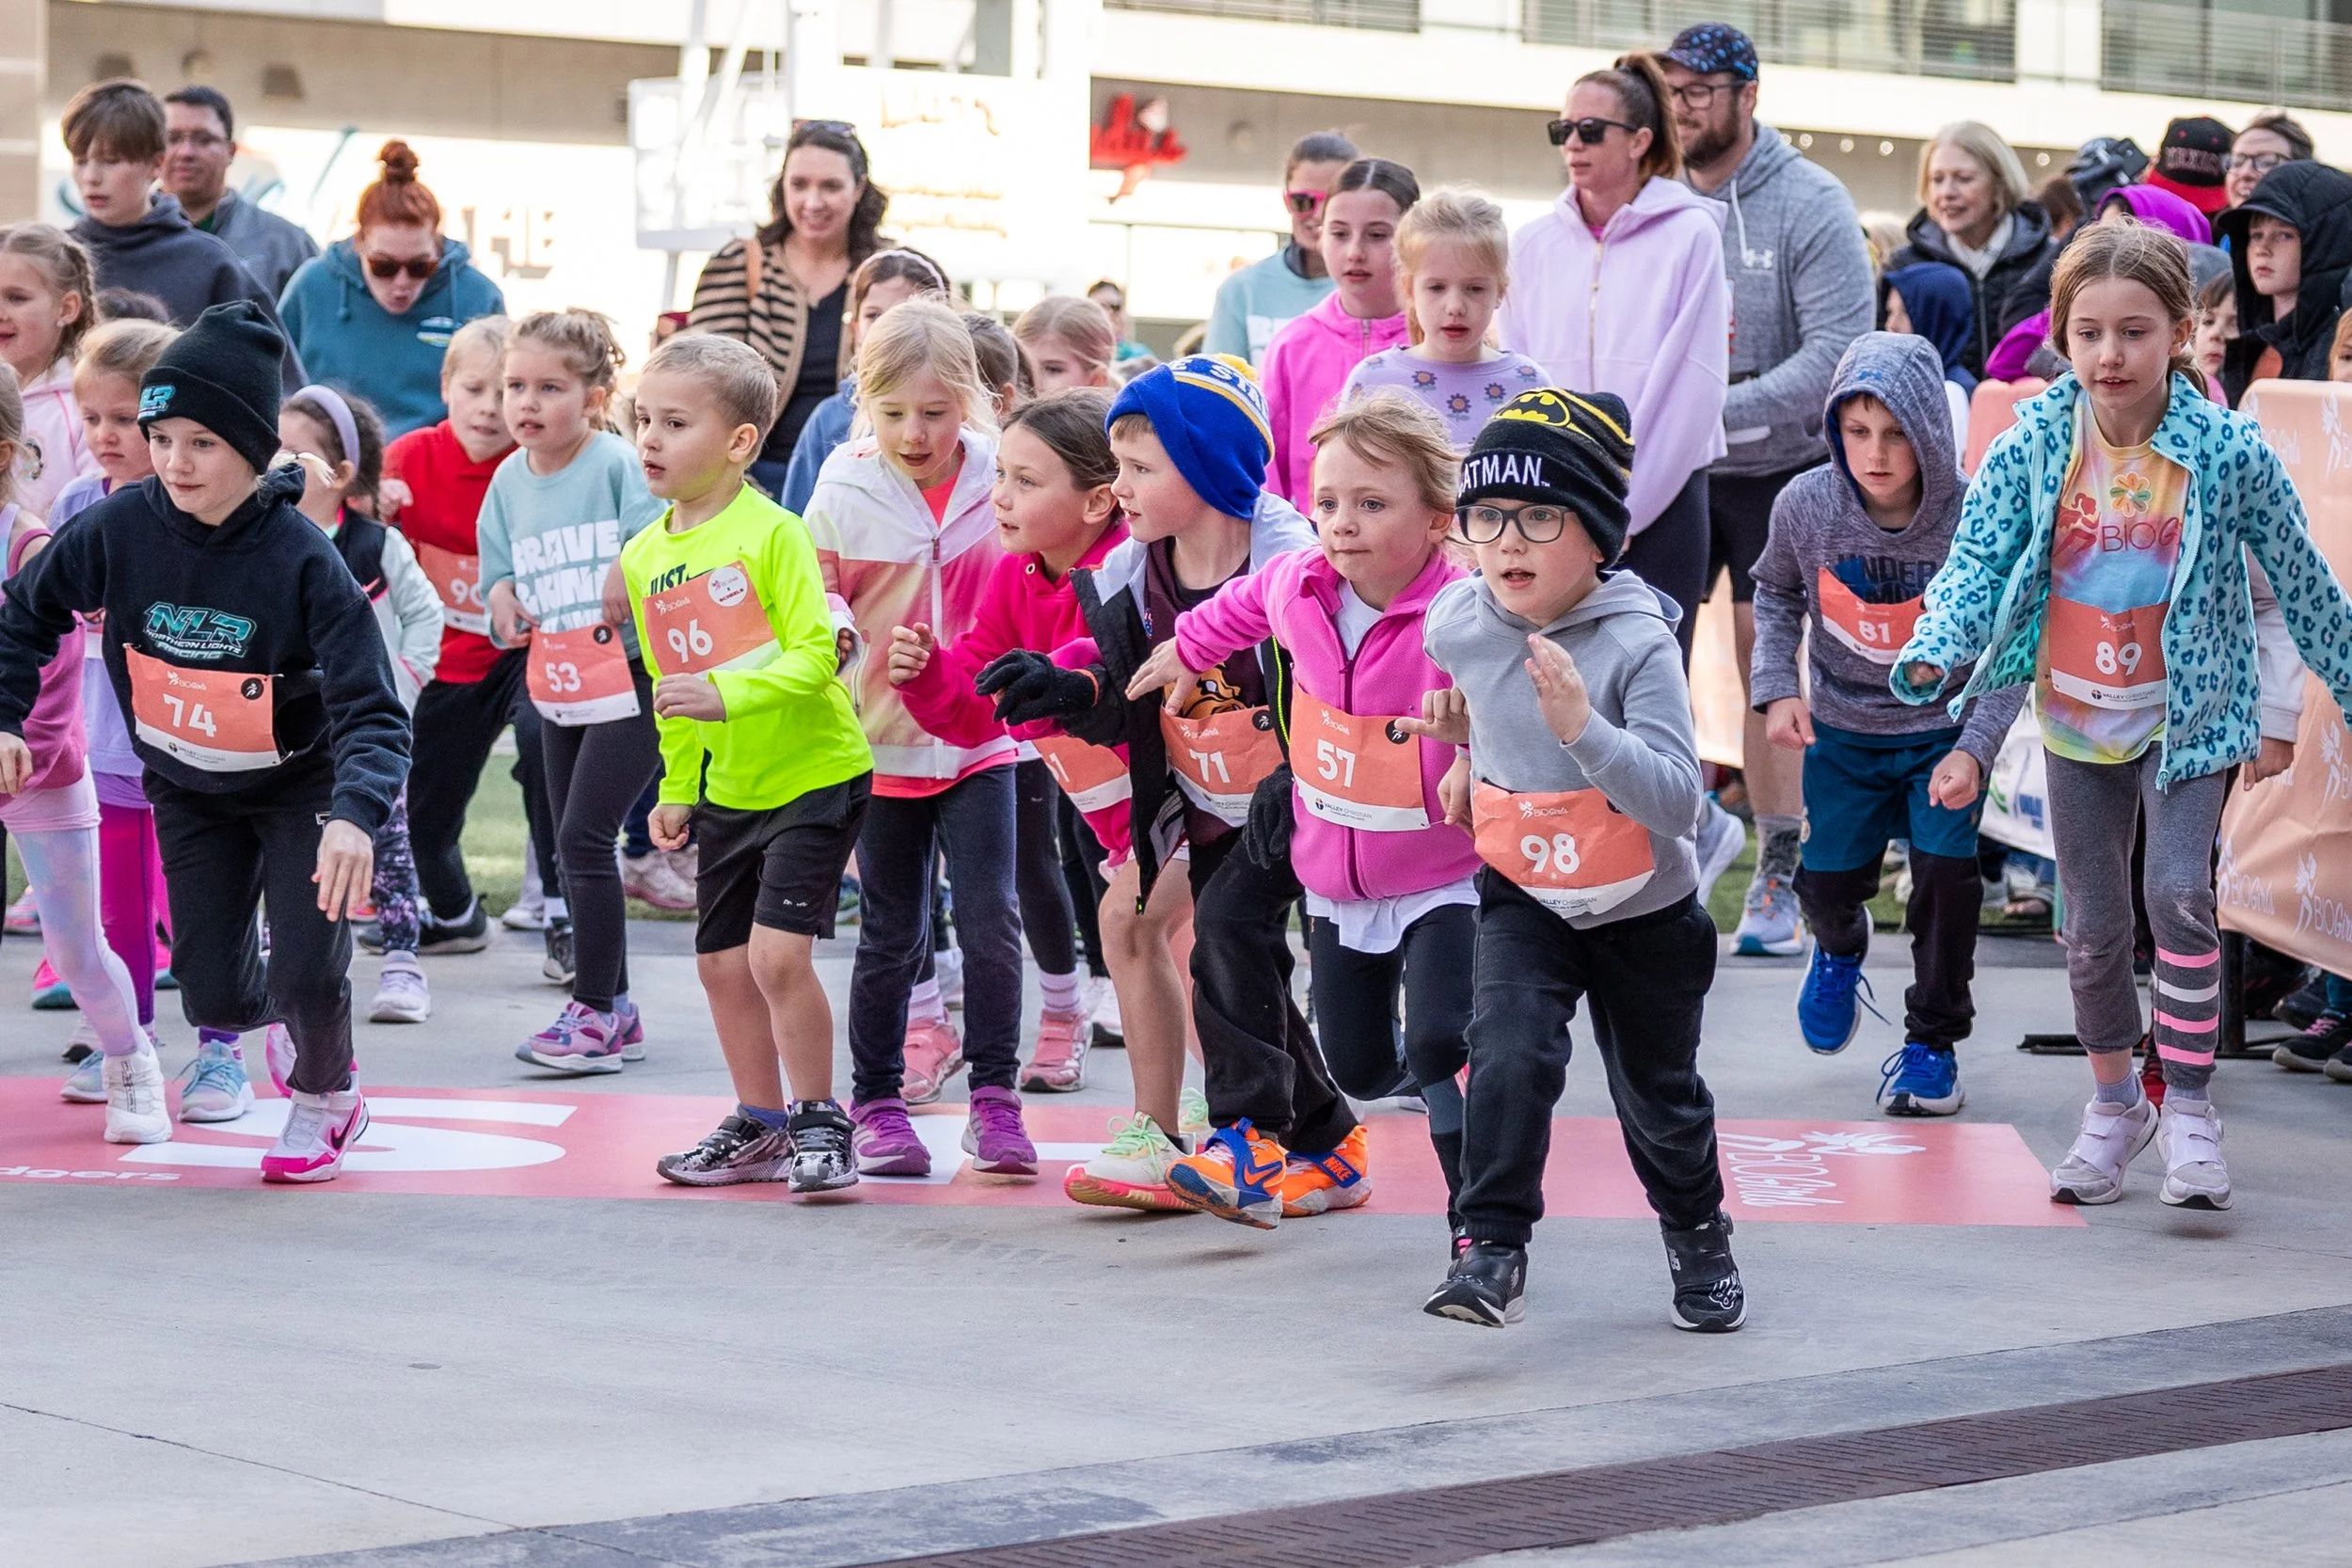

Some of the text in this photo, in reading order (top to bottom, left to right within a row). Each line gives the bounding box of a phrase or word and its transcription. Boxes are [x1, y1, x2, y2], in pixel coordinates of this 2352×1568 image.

[511, 519, 621, 578] BRAVE
[146, 602, 257, 649] NLR
[667, 619, 713, 663] 96
[1859, 620, 1891, 643] 81
[546, 661, 581, 693] 53
[2095, 641, 2142, 675] 89
[163, 692, 217, 737] 74
[1189, 748, 1231, 784] 71
[1317, 738, 1356, 788] 57
[1520, 833, 1580, 875] 98
[1323, 1155, 1353, 1182] NIKE
